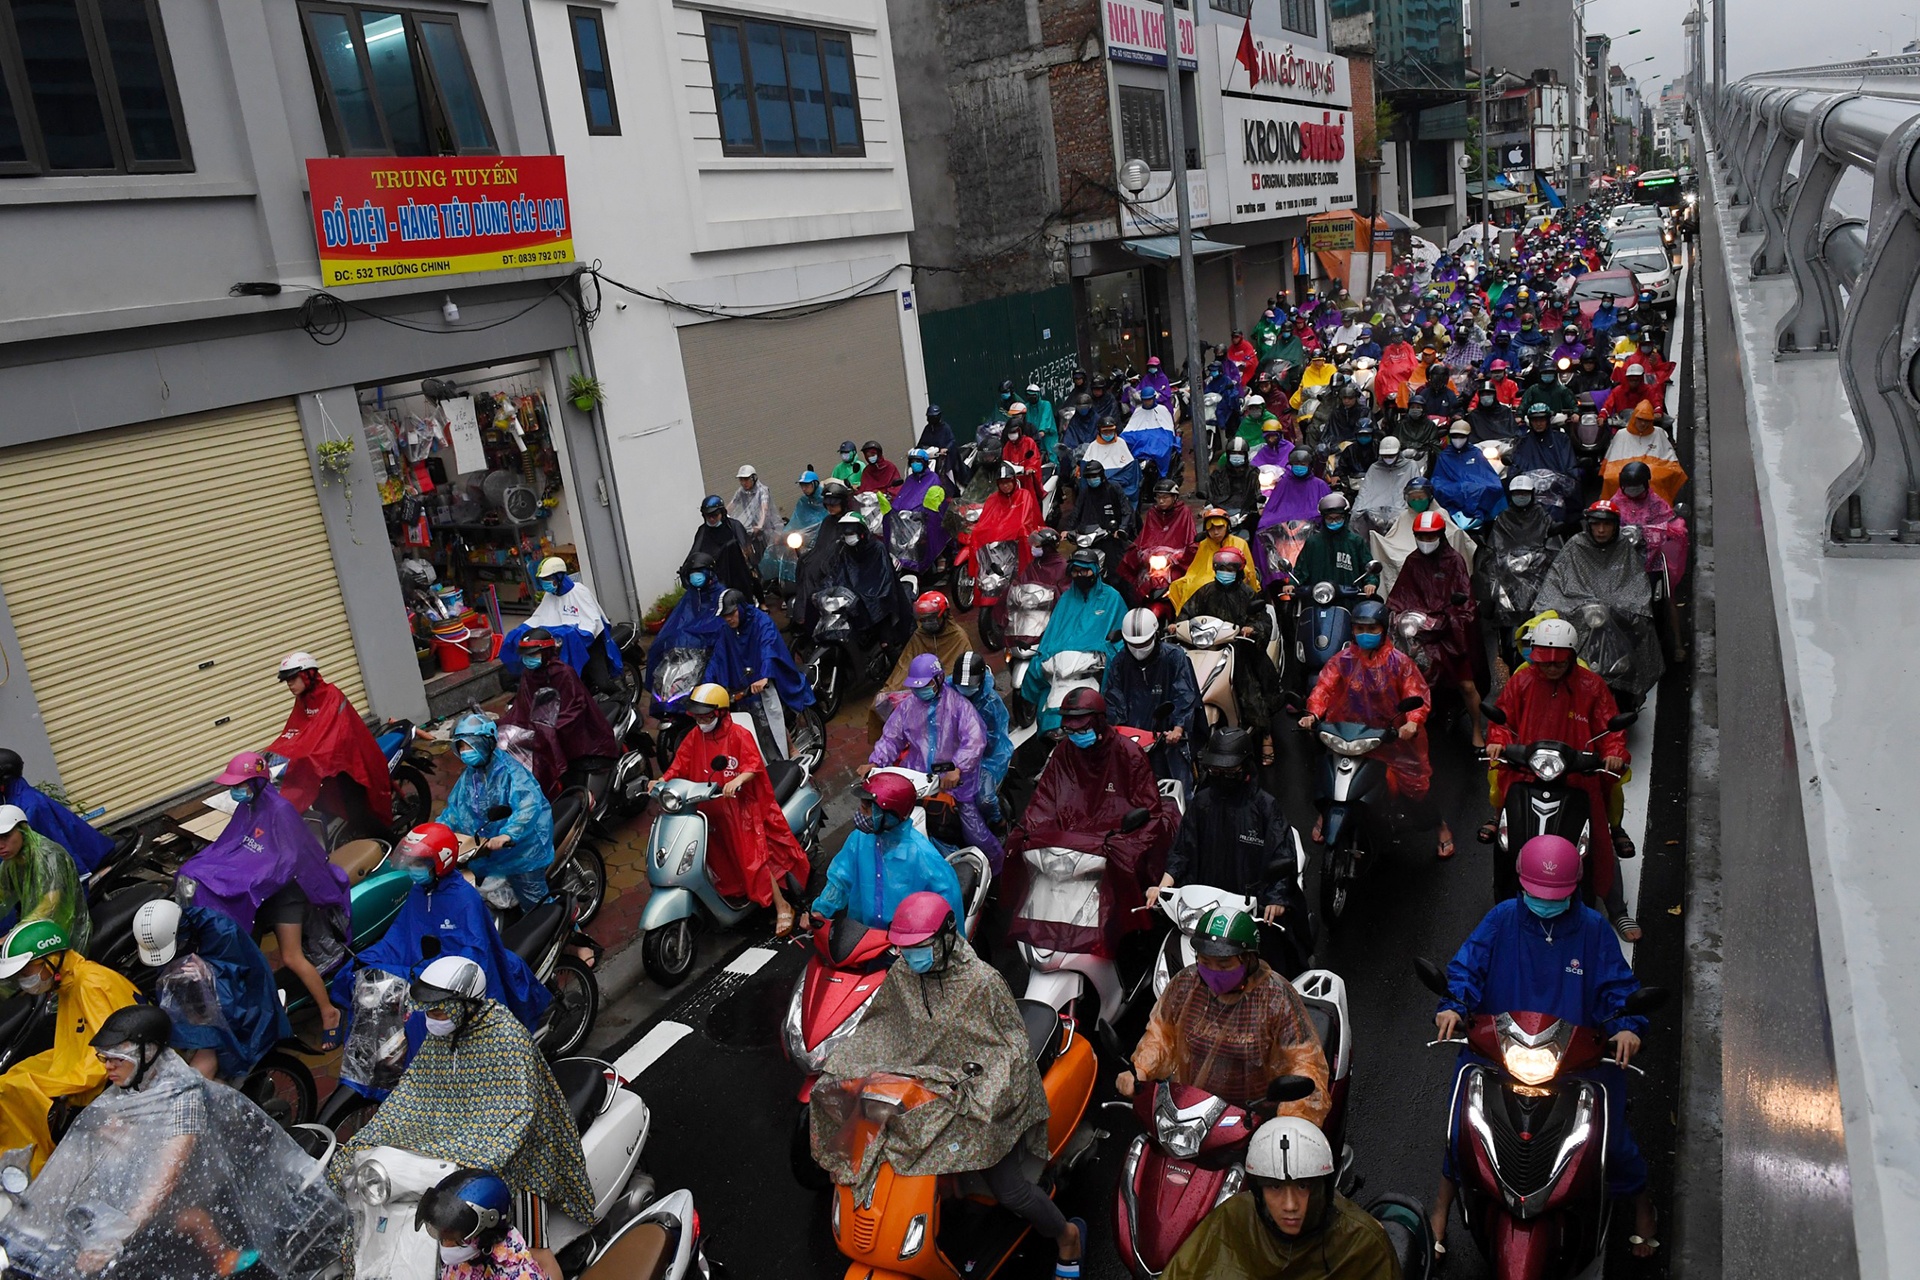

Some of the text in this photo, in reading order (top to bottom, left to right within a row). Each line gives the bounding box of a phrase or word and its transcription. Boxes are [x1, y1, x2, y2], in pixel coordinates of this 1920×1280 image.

[1107, 2, 1140, 46] NHA
[1178, 17, 1195, 55] 3D
[1280, 44, 1297, 86] GỖ
[371, 160, 518, 189] TRUNG TUYẾN
[1261, 171, 1339, 190] ORIGINAL SWISS MADE FLOORING
[322, 196, 348, 247] ĐỒ
[347, 199, 388, 252] ĐIỆN
[397, 197, 441, 242] HÀNG
[440, 196, 473, 239] TIÊU
[472, 194, 512, 237] DÙNG
[510, 193, 538, 234] CÁC
[537, 198, 567, 238] LOẠI
[1311, 220, 1354, 234] NHÀ NGHỈ
[502, 249, 567, 265] ĐT: 0839 792 079
[334, 260, 451, 282] ĐC: 532 TRƯỜNG CHINH
[242, 834, 265, 853] PBank
[36, 934, 62, 950] Grab
[1564, 966, 1584, 976] SCB
[1166, 1163, 1191, 1175] HONDA
